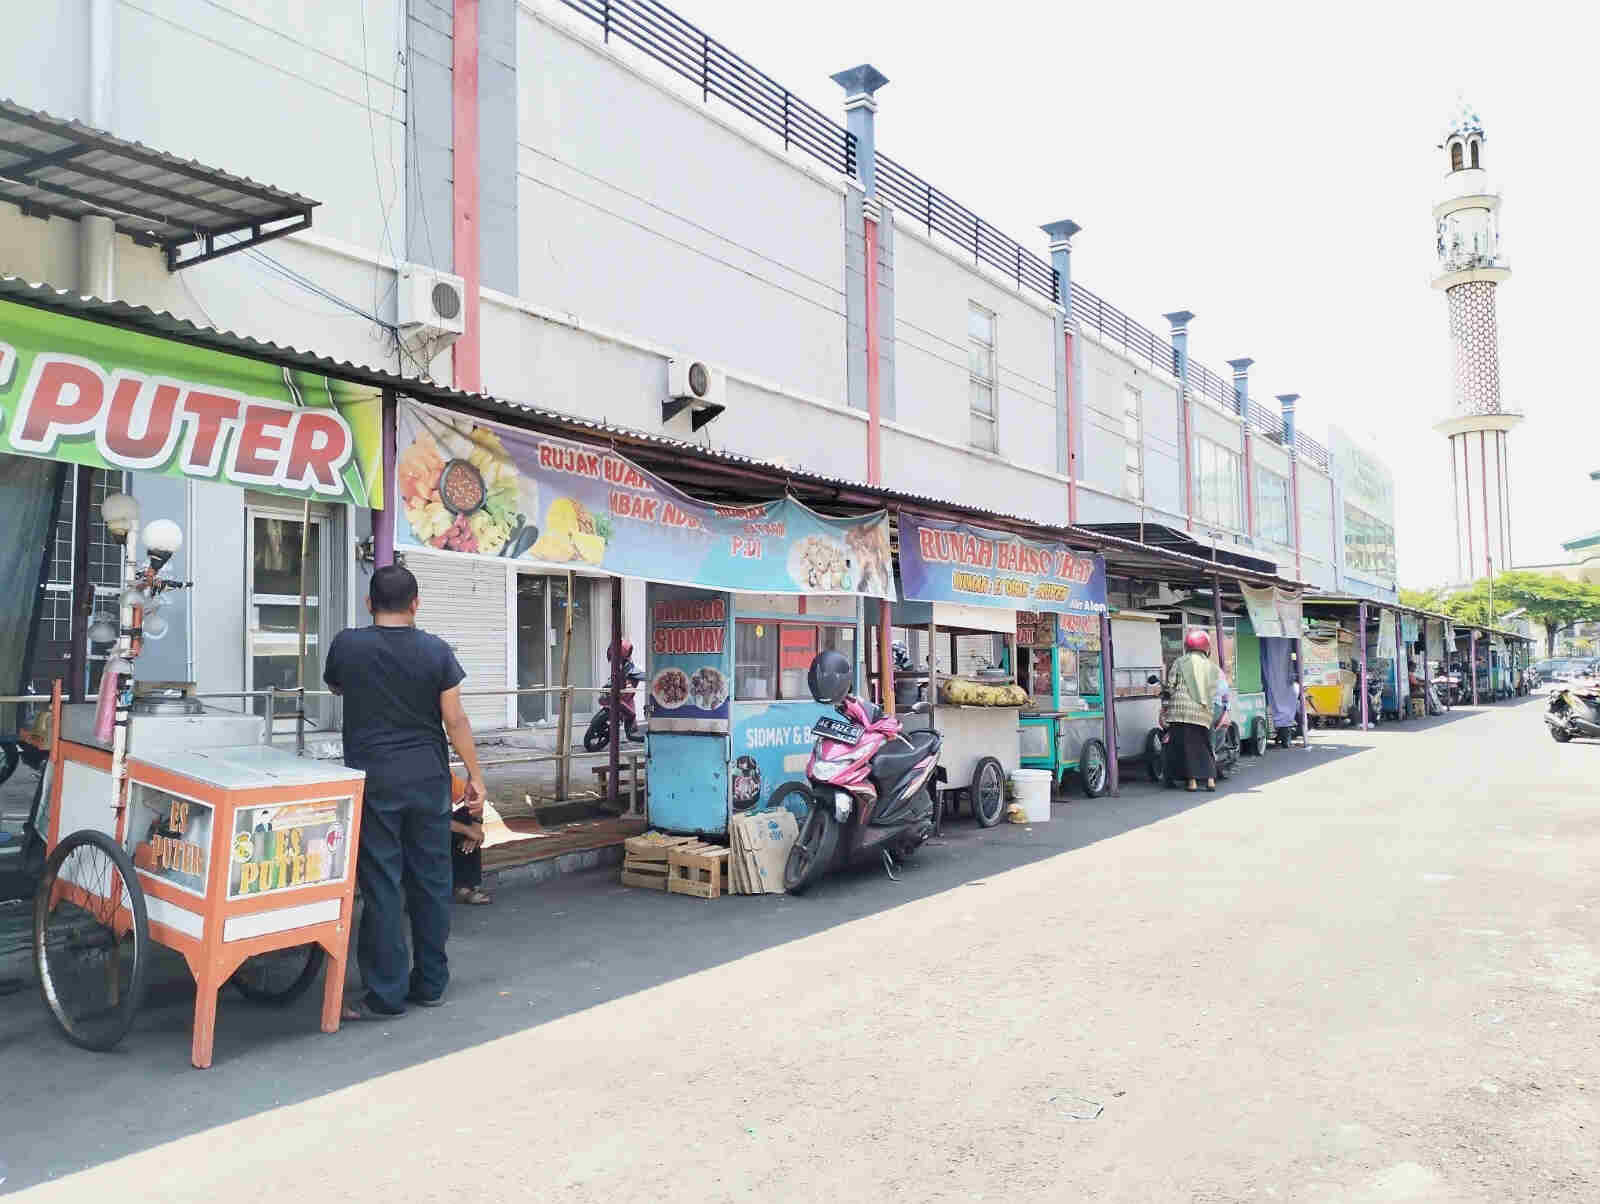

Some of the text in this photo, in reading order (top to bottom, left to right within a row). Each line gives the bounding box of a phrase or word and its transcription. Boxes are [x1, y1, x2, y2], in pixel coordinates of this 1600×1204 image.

[12, 354, 351, 495] PUTER
[538, 443, 602, 479] RUJAK
[652, 627, 727, 654] SIOMAY
[746, 726, 791, 749] SIOMAY
[793, 726, 802, 745] &
[169, 799, 190, 833] ES
[151, 833, 205, 875] PUTER
[276, 827, 304, 858] ES
